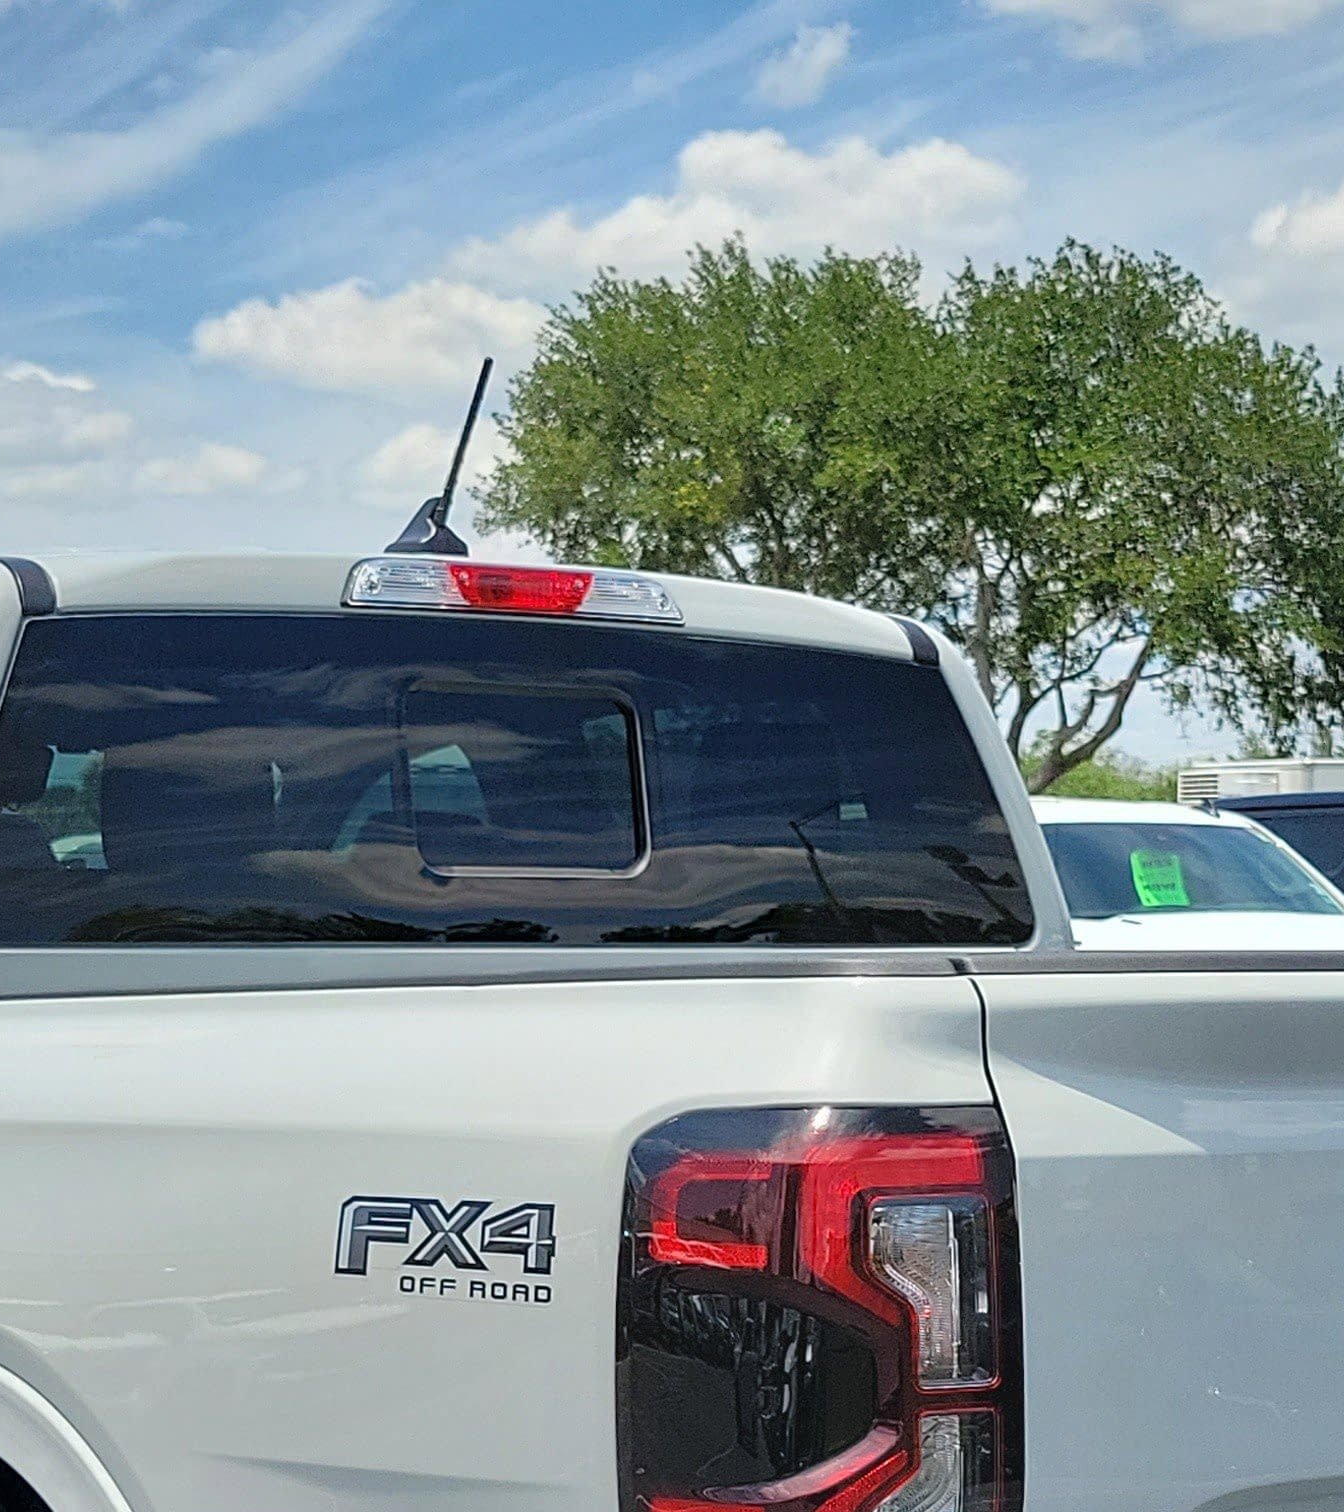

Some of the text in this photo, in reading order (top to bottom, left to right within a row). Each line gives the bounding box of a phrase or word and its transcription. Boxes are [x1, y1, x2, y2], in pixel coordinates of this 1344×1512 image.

[335, 1195, 556, 1276] FX4
[400, 1276, 553, 1303] OFF ROAD
